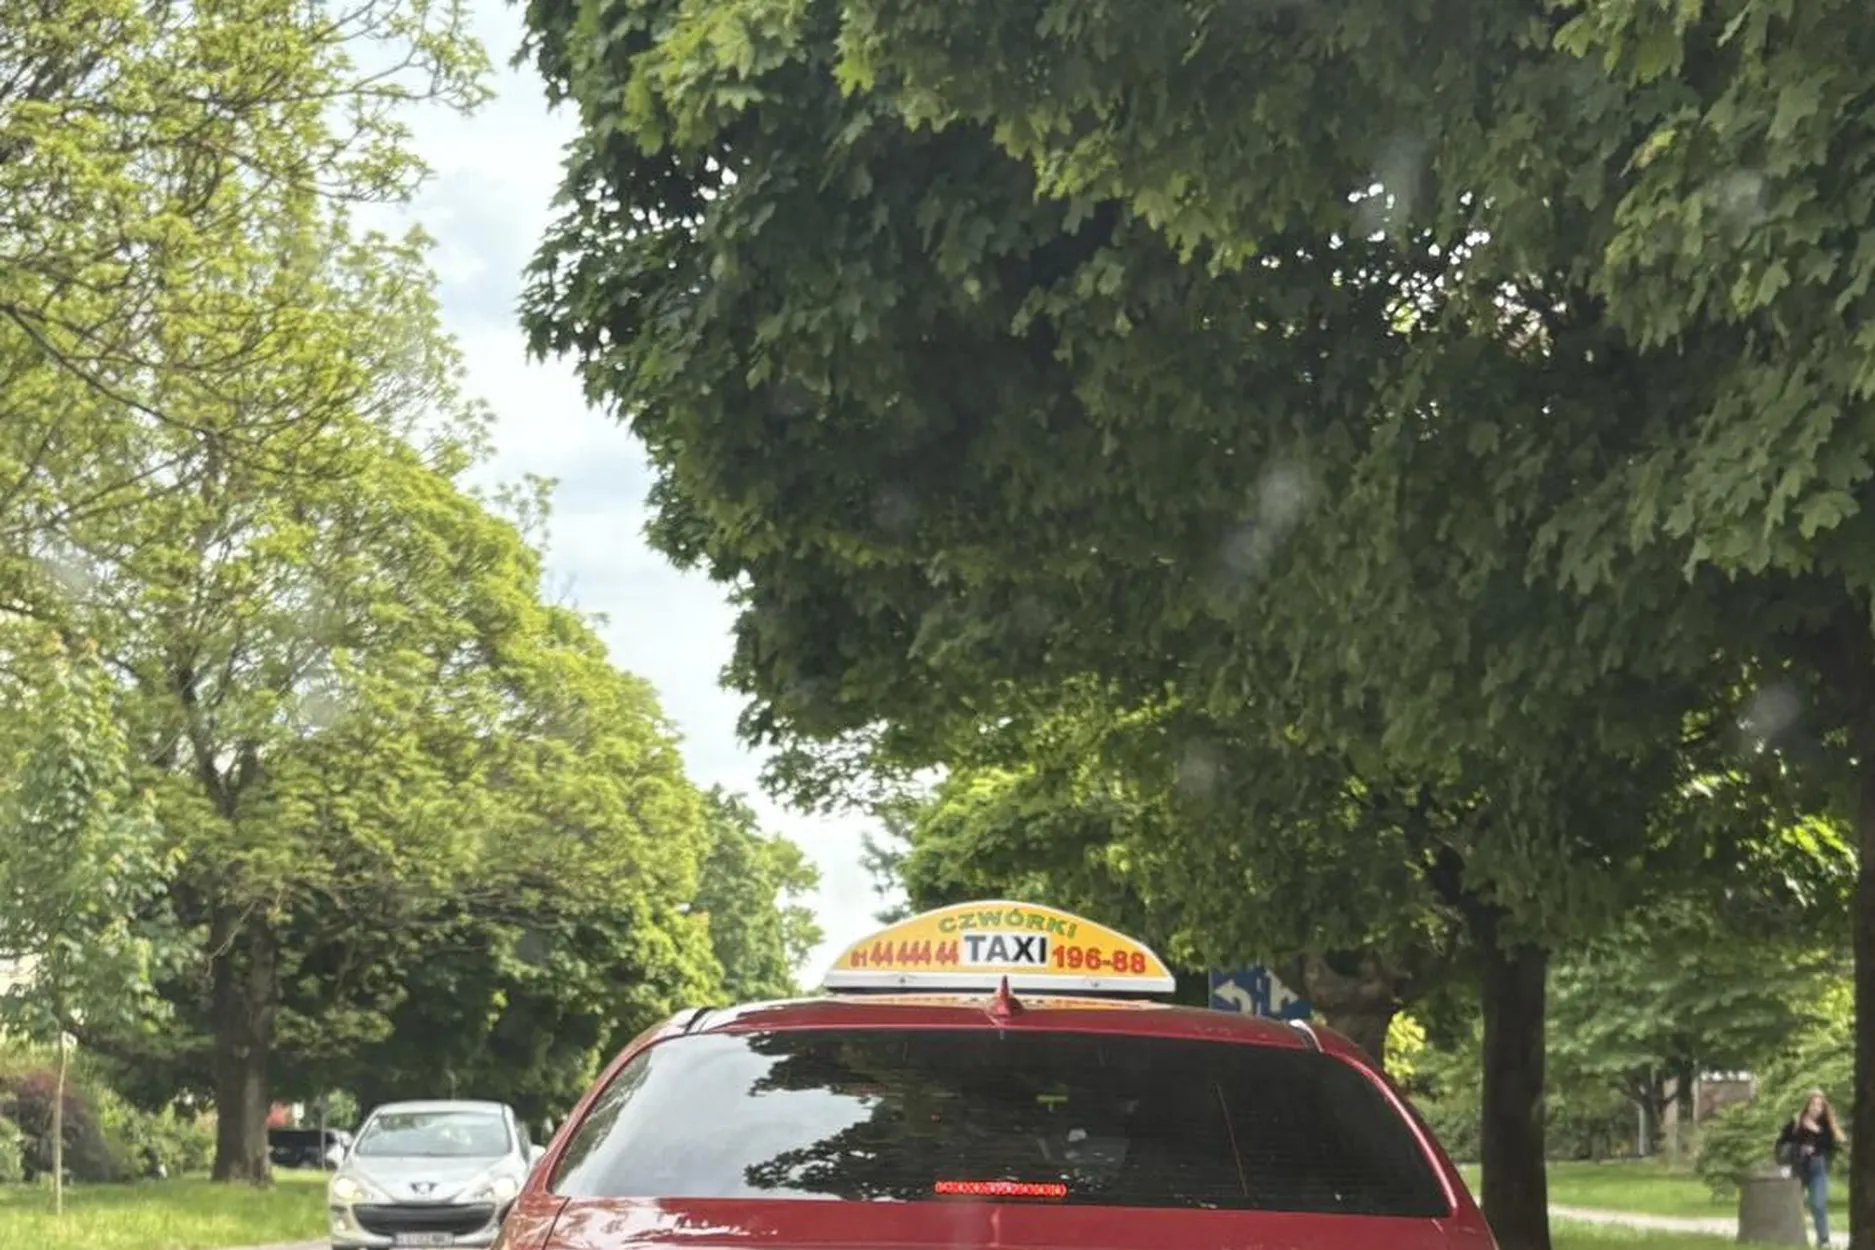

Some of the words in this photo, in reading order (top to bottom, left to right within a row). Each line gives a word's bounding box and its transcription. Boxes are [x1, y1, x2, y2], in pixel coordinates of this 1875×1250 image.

[937, 908, 1078, 940] CZWÓRKI
[964, 934, 1048, 964] TAXI
[1052, 944, 1147, 974] 196-88
